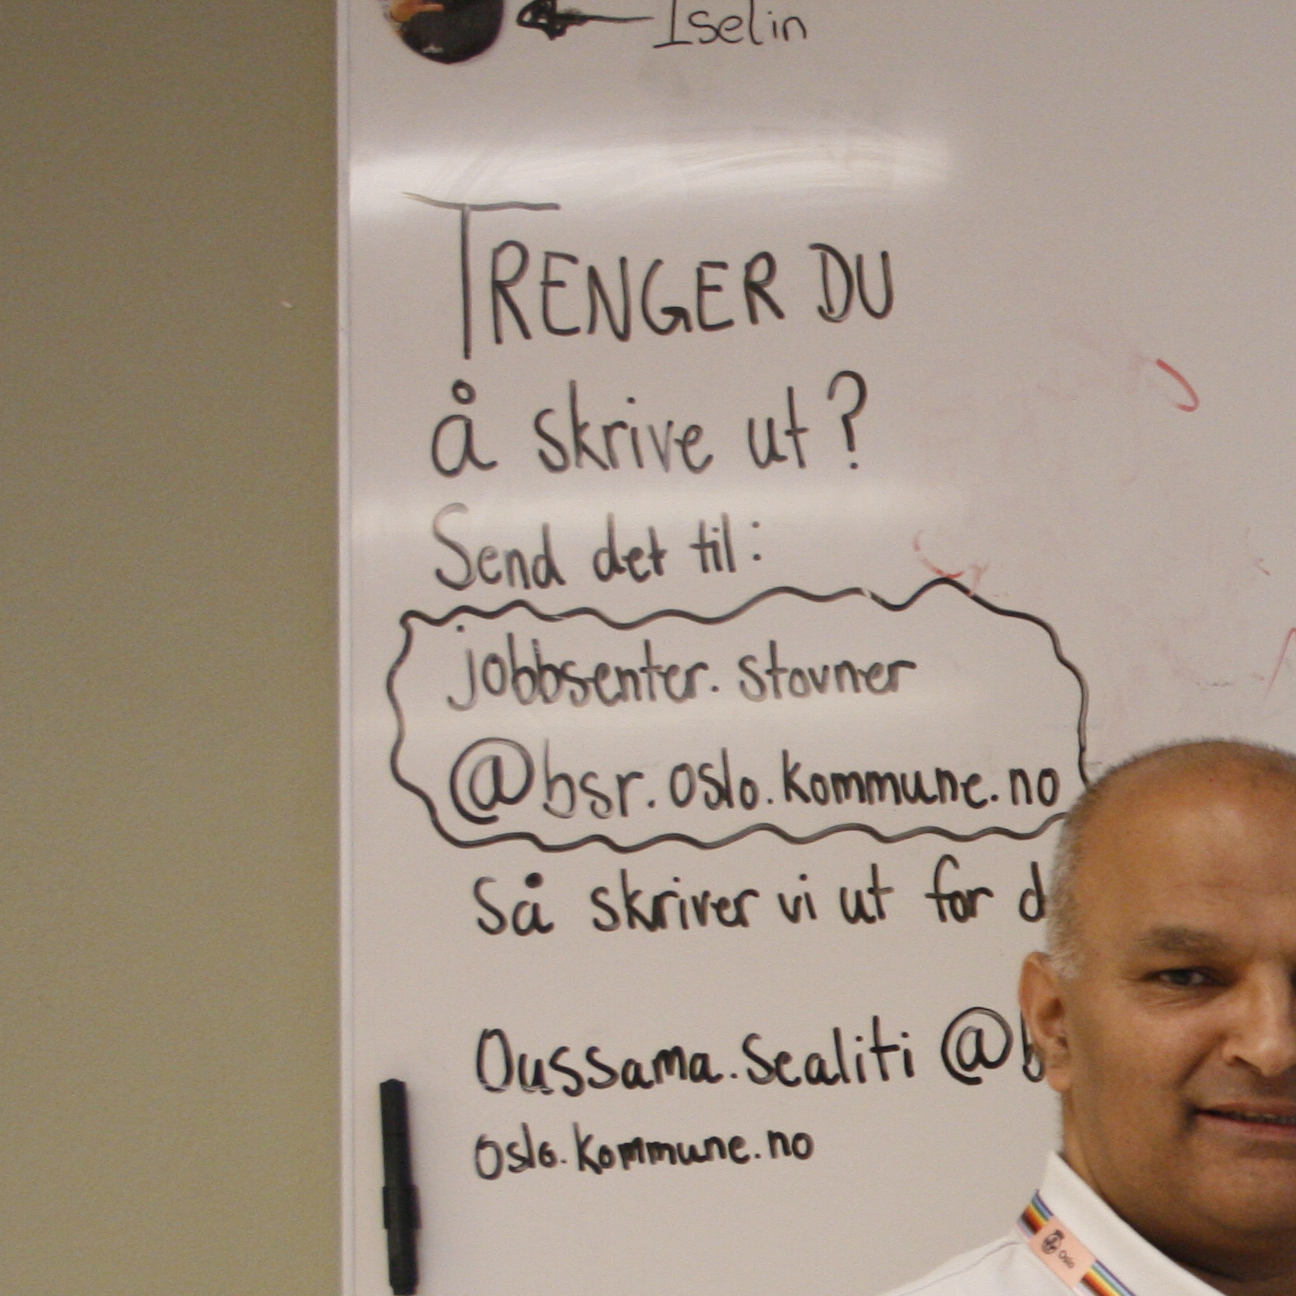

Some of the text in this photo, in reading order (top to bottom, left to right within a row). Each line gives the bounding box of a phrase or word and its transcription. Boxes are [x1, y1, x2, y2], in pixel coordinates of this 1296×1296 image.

[652, 0, 808, 49] Iselin
[402, 190, 895, 361] TRENGER DU
[431, 378, 498, 478] å
[534, 378, 714, 475] skrive
[432, 502, 566, 592] Send
[592, 512, 668, 580] det
[591, 867, 761, 934] skriver
[777, 873, 819, 924] vi
[841, 863, 896, 923] ut
[925, 854, 996, 925] for
[1058, 1249, 1076, 1269] Oslo
